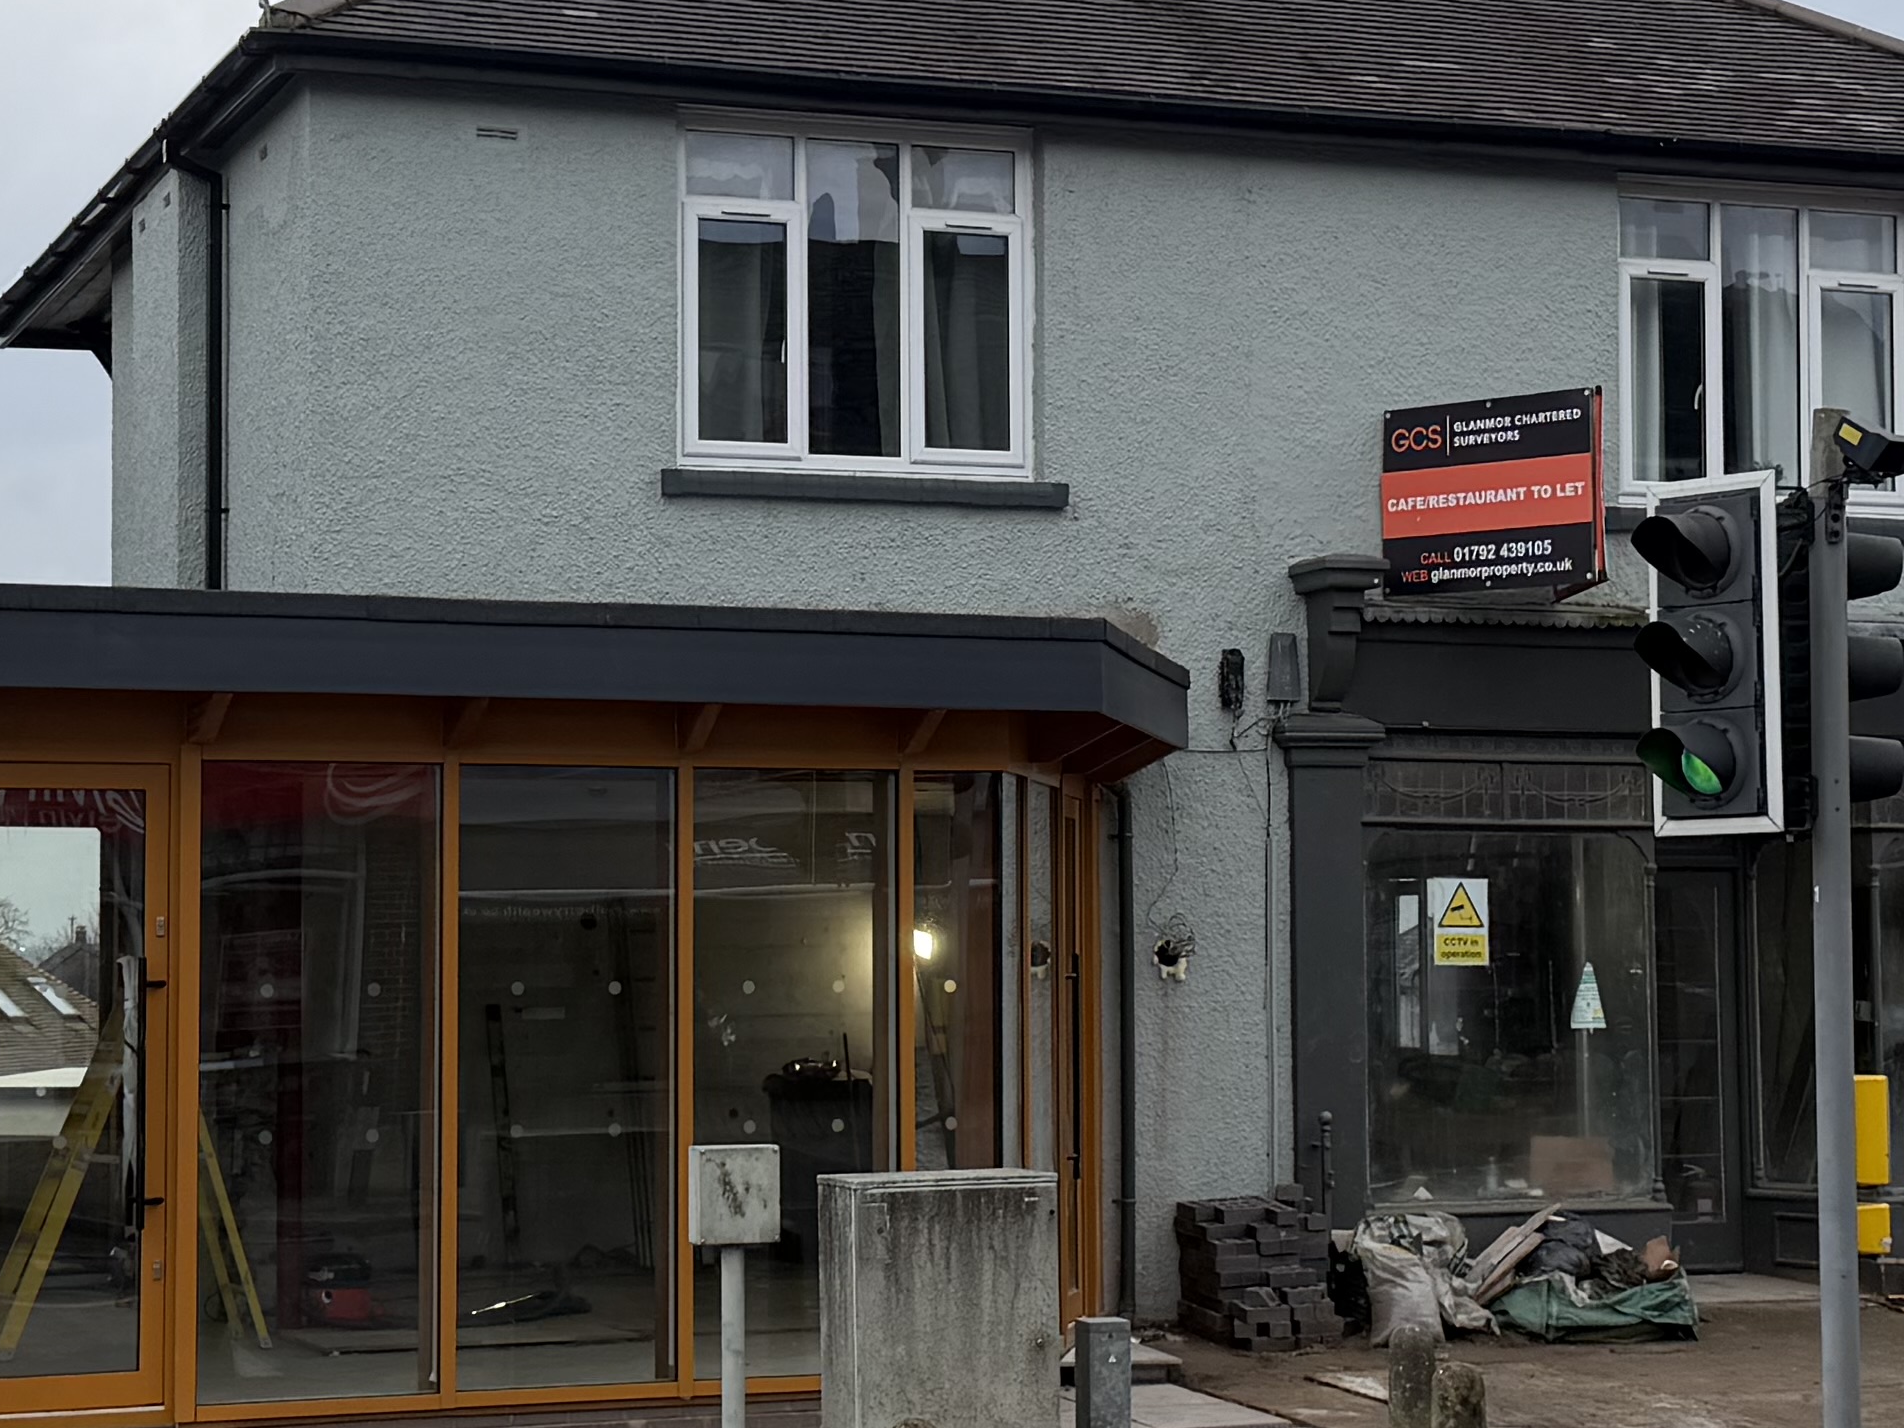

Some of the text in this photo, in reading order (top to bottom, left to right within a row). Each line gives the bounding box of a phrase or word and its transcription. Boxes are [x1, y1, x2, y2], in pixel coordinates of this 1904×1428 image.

[1453, 408, 1581, 433] GLANMOR CHARTERED
[1391, 425, 1442, 453] GCS
[1453, 429, 1520, 448] SURVEYORS
[1387, 481, 1585, 512] CAFE/RESTAURANT TO LET
[1420, 539, 1552, 565] CALL 01792 439105
[1401, 557, 1573, 583] WEB glanmorproperty.co.uk
[1443, 937, 1479, 947] CCTV in
[1440, 950, 1482, 960] operation
